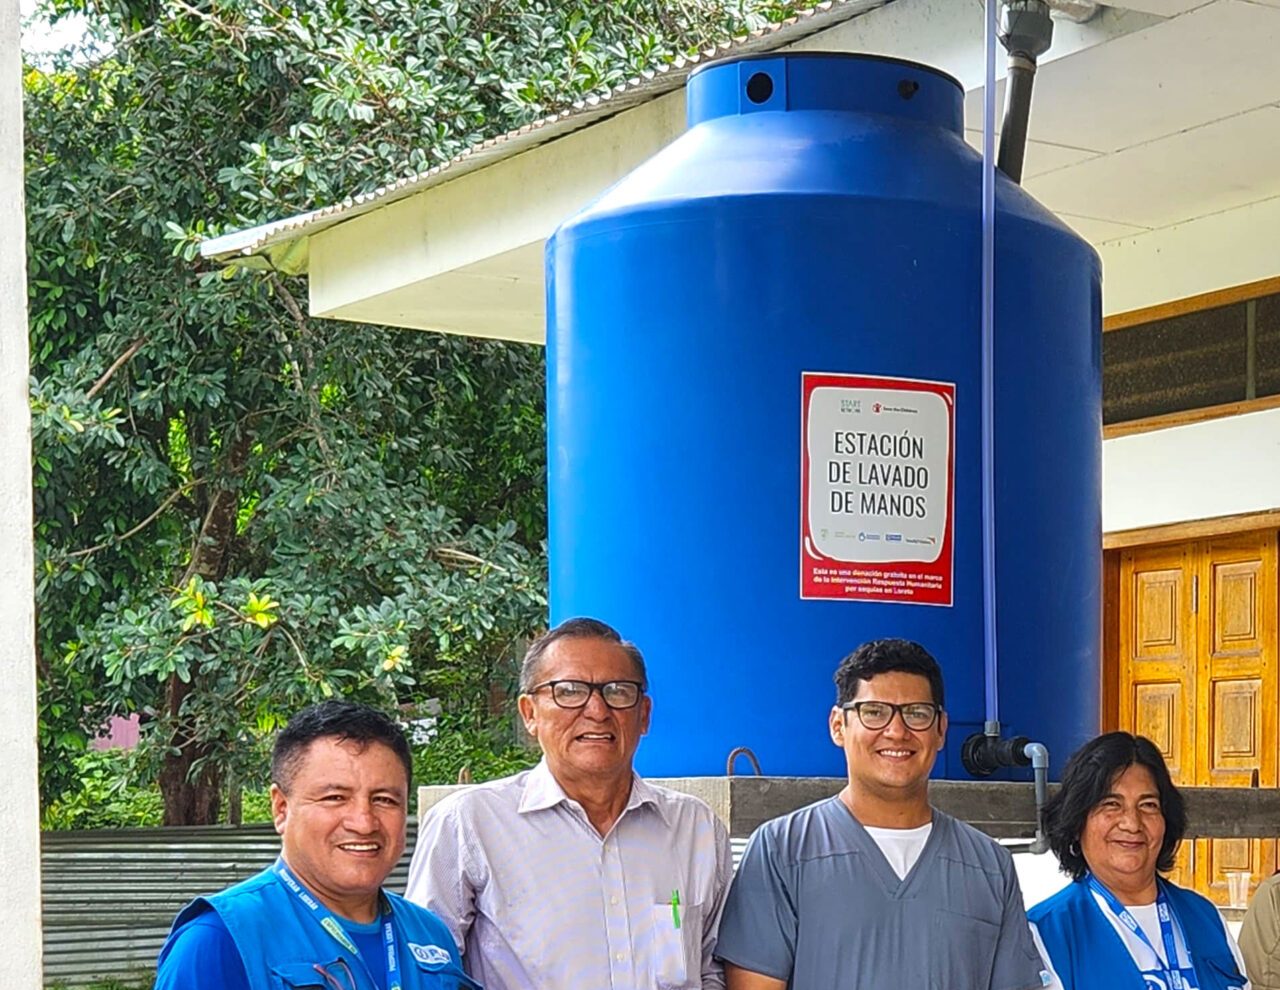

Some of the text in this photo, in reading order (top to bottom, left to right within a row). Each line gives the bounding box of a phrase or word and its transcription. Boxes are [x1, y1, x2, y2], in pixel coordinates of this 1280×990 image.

[835, 430, 923, 459] ESTACIÓN
[829, 461, 928, 489] DE LAVADO
[831, 491, 926, 518] DE MANOS
